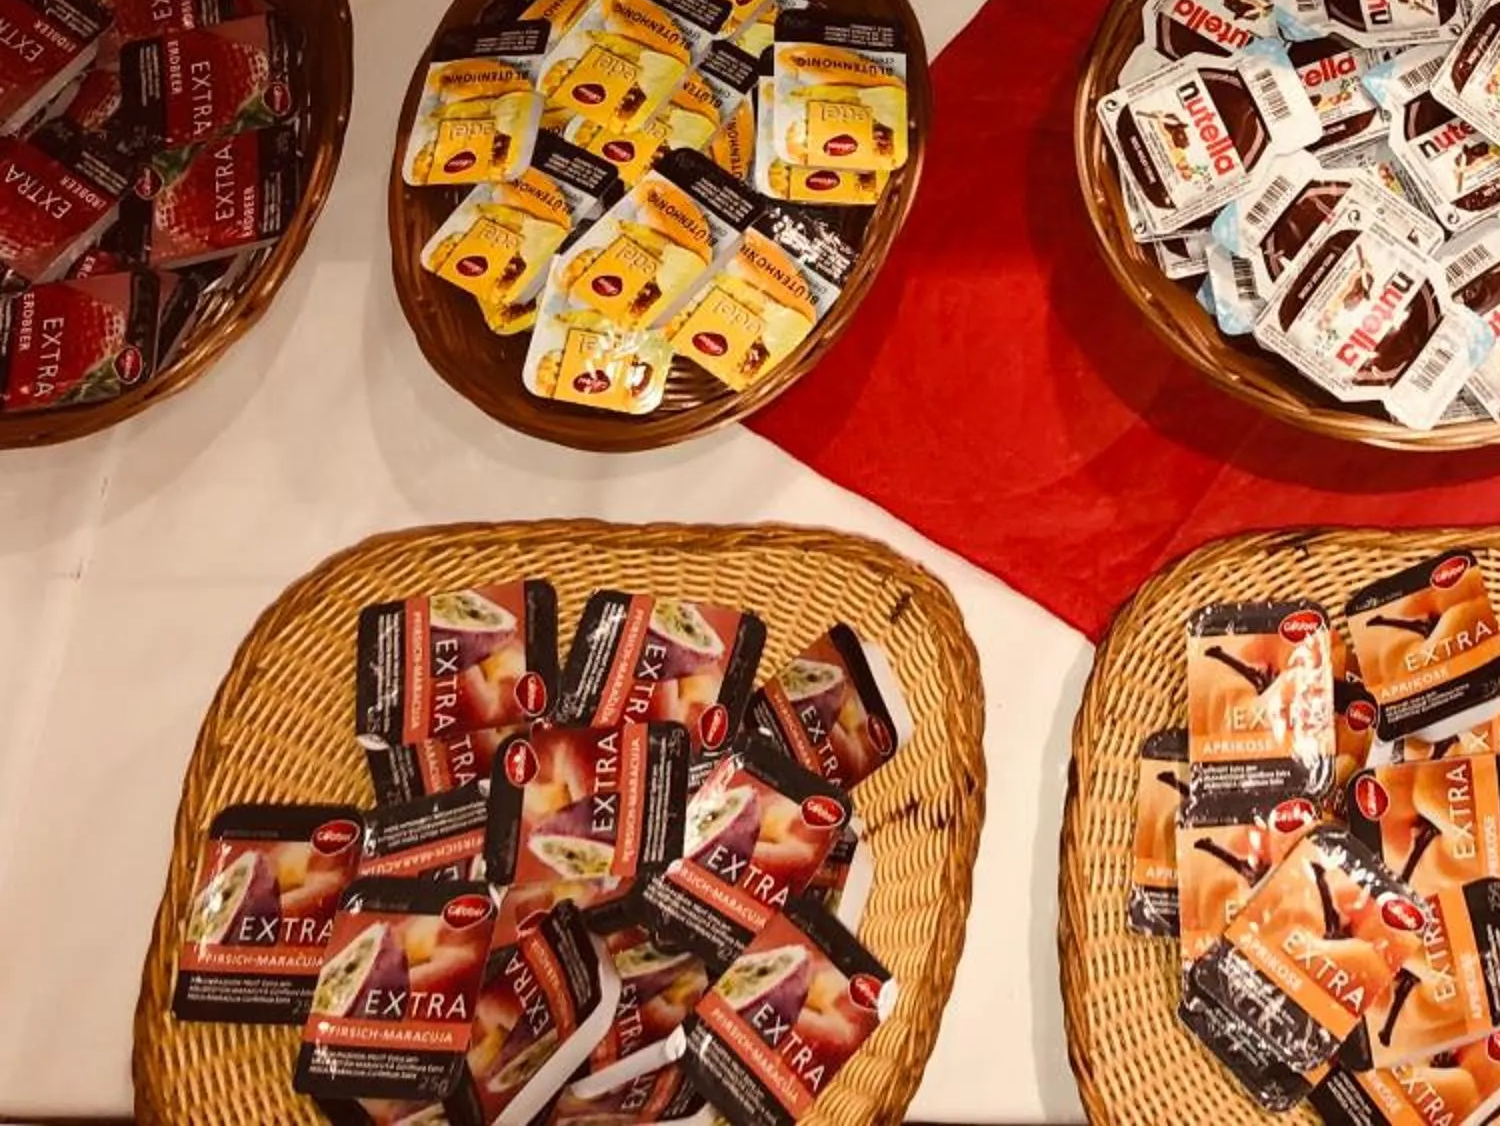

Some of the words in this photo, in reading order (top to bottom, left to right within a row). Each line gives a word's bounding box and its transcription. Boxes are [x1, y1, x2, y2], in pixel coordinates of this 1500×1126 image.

[0, 17, 45, 62] EXT
[1303, 54, 1358, 88] ella
[191, 61, 213, 137] EXTRA
[1176, 80, 1236, 176] nutella
[1417, 120, 1476, 159] nute
[5, 163, 73, 220] EXTRA
[214, 143, 235, 222] EXTRA
[18, 292, 35, 352] ERDBEER
[1335, 270, 1415, 366] nutella
[33, 316, 65, 398] EXTRA
[1405, 620, 1493, 672] EXTRA
[434, 638, 459, 733] EXTRA
[450, 734, 476, 787] TRA
[592, 732, 619, 833] EXTRA
[1446, 764, 1477, 860] EXTRA
[707, 844, 790, 908] EXTRA
[239, 916, 334, 943] EXTRA
[364, 989, 467, 1019] EXTRA
[505, 952, 550, 1037] EXTRA
[1282, 930, 1365, 1013] EXTRA
[753, 1002, 826, 1091] EXTRA
